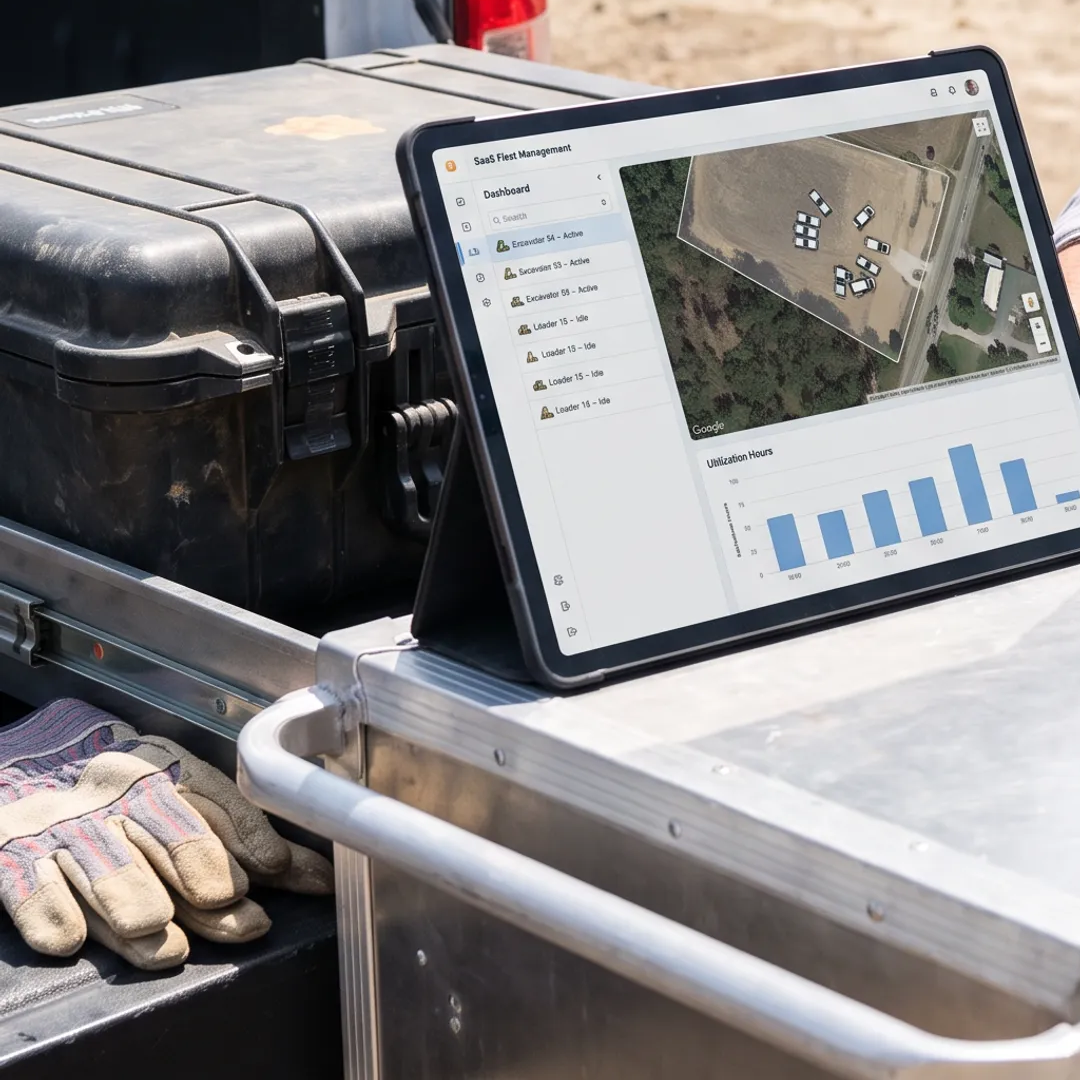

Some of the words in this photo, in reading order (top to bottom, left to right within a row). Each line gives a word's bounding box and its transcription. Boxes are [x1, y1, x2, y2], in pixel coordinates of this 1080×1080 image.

[473, 154, 496, 166] SaaS
[483, 183, 531, 200] Dashboard
[563, 230, 584, 240] Active
[569, 257, 590, 267] Active
[578, 284, 599, 294] Active
[533, 320, 558, 331] Loader
[548, 375, 573, 387] Loader
[692, 420, 725, 435] Google
[748, 447, 773, 460] Hours
